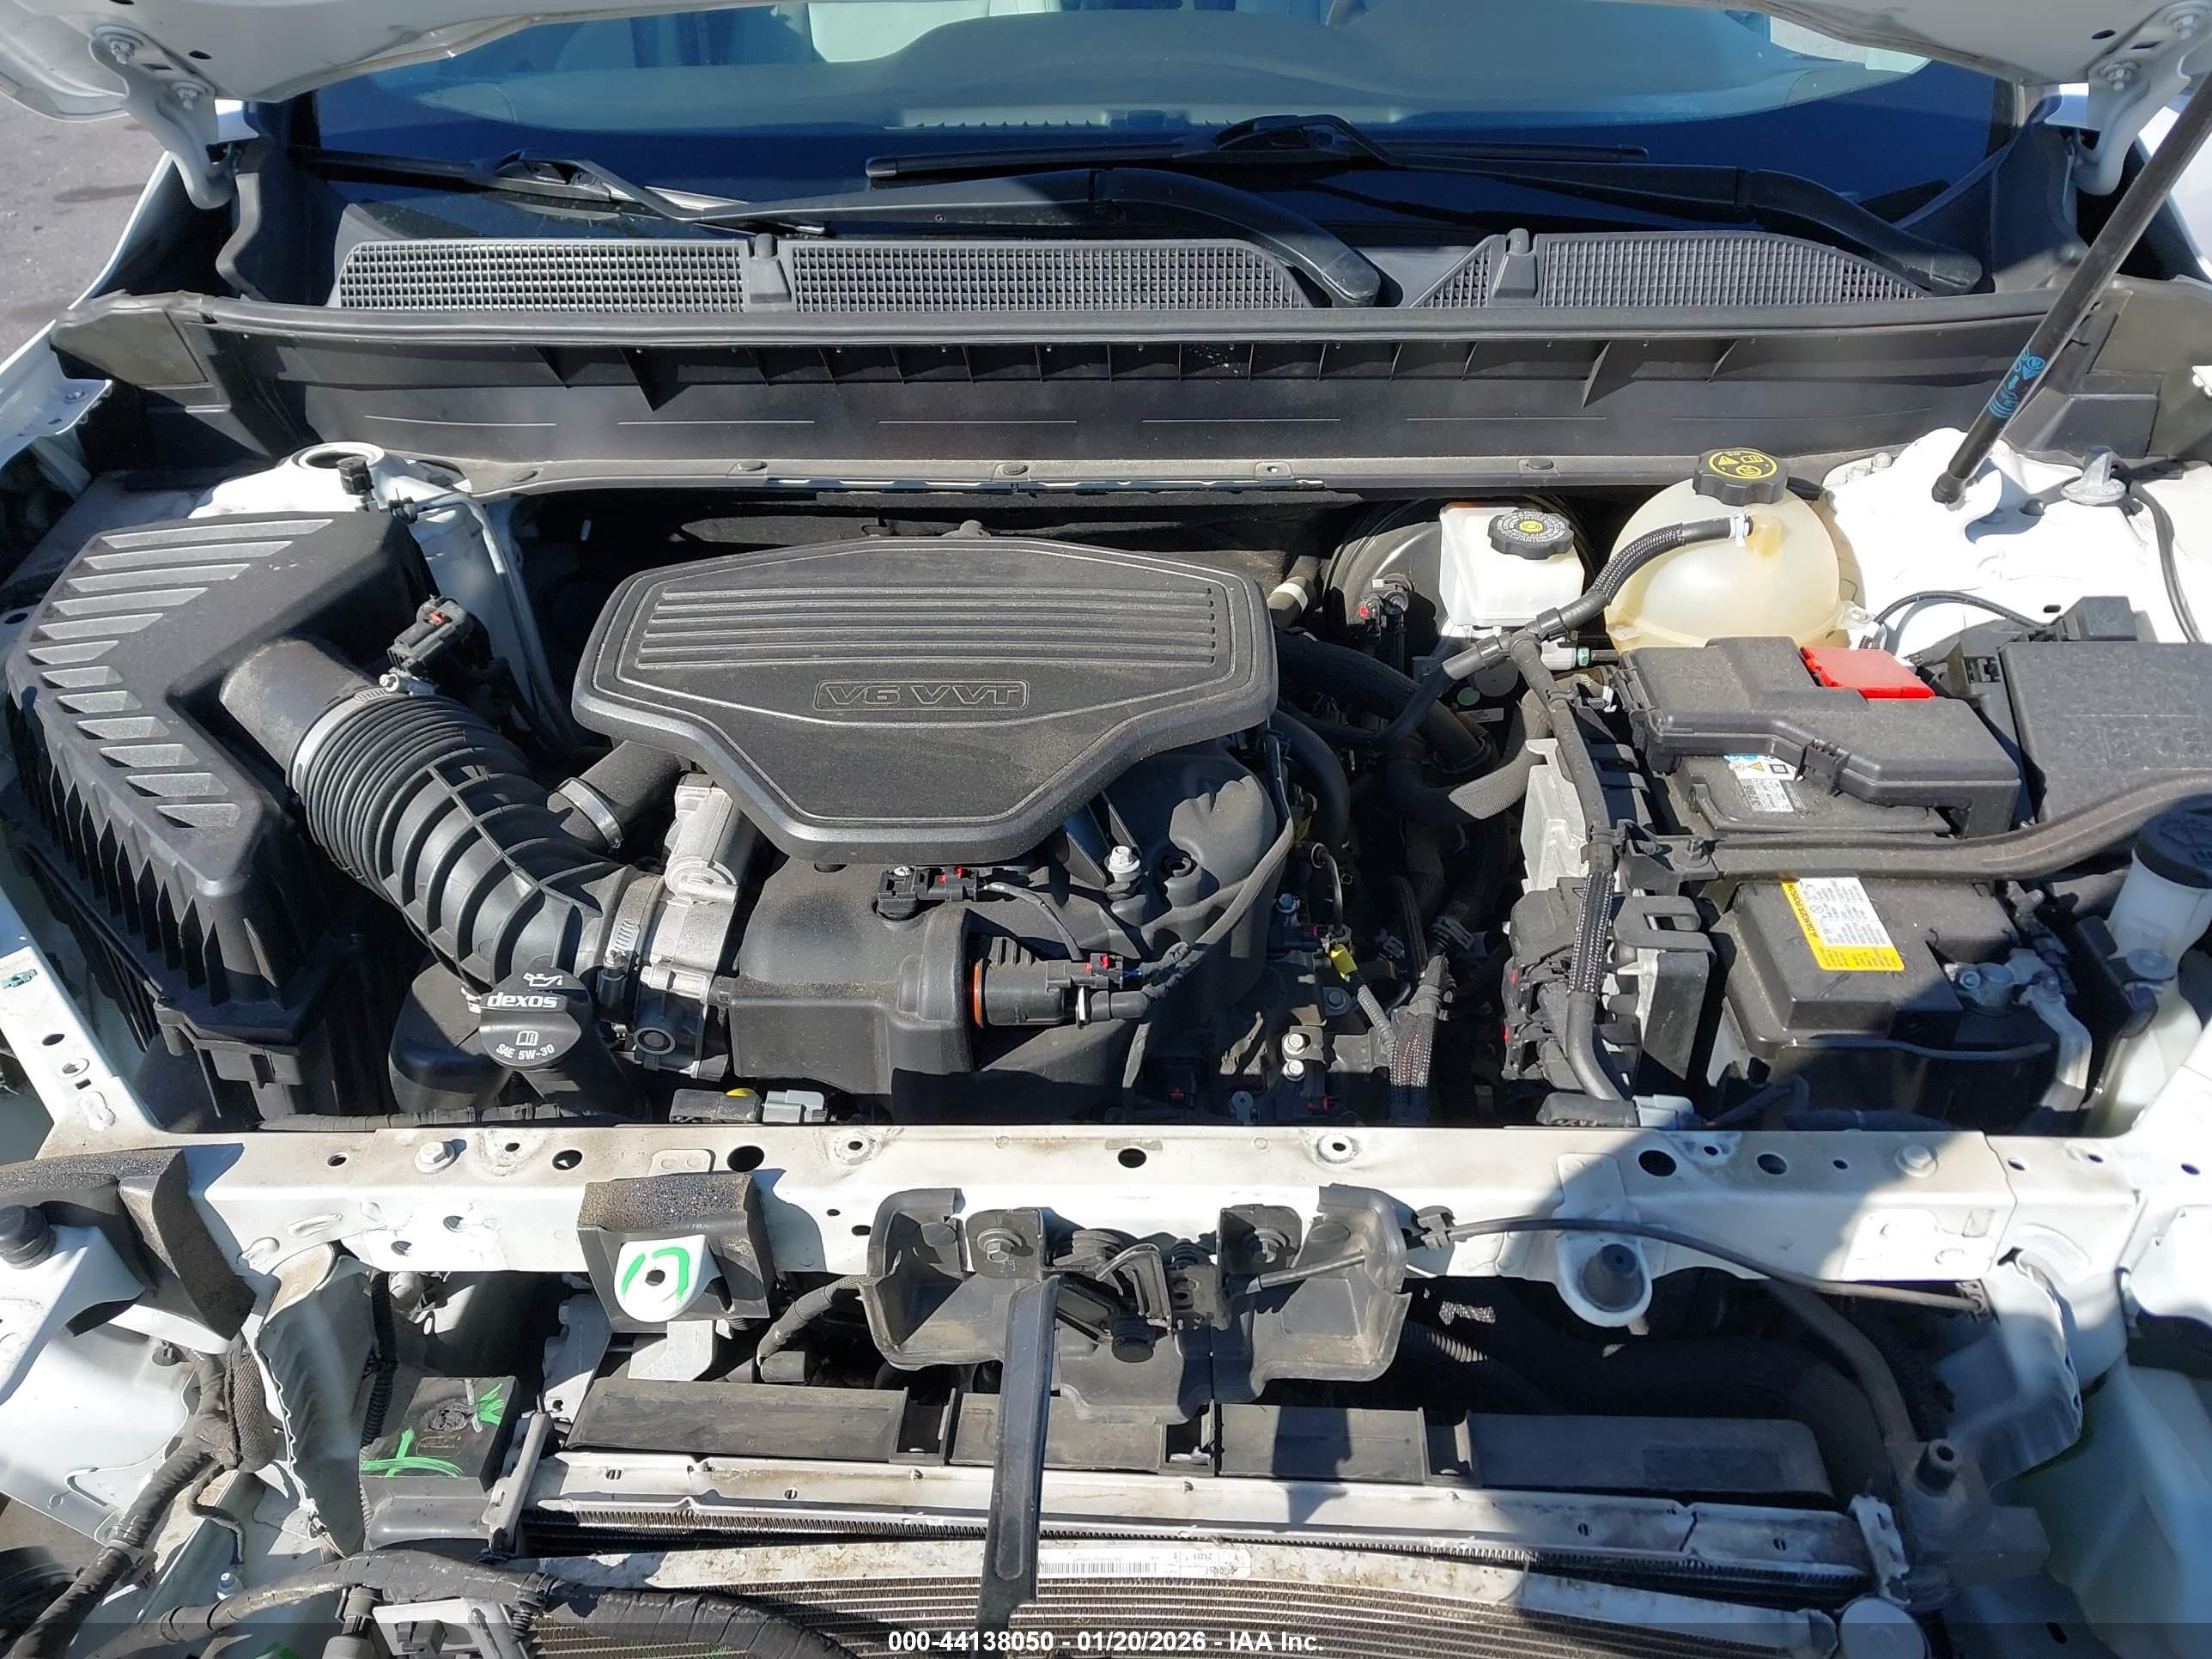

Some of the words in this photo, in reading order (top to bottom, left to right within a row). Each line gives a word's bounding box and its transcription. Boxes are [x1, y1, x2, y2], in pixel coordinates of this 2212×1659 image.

[825, 685, 901, 705] V6
[909, 685, 1020, 705] VVT
[487, 992, 558, 1008] dexos
[495, 1043, 515, 1059] SAE
[518, 1043, 556, 1060] 5W-30
